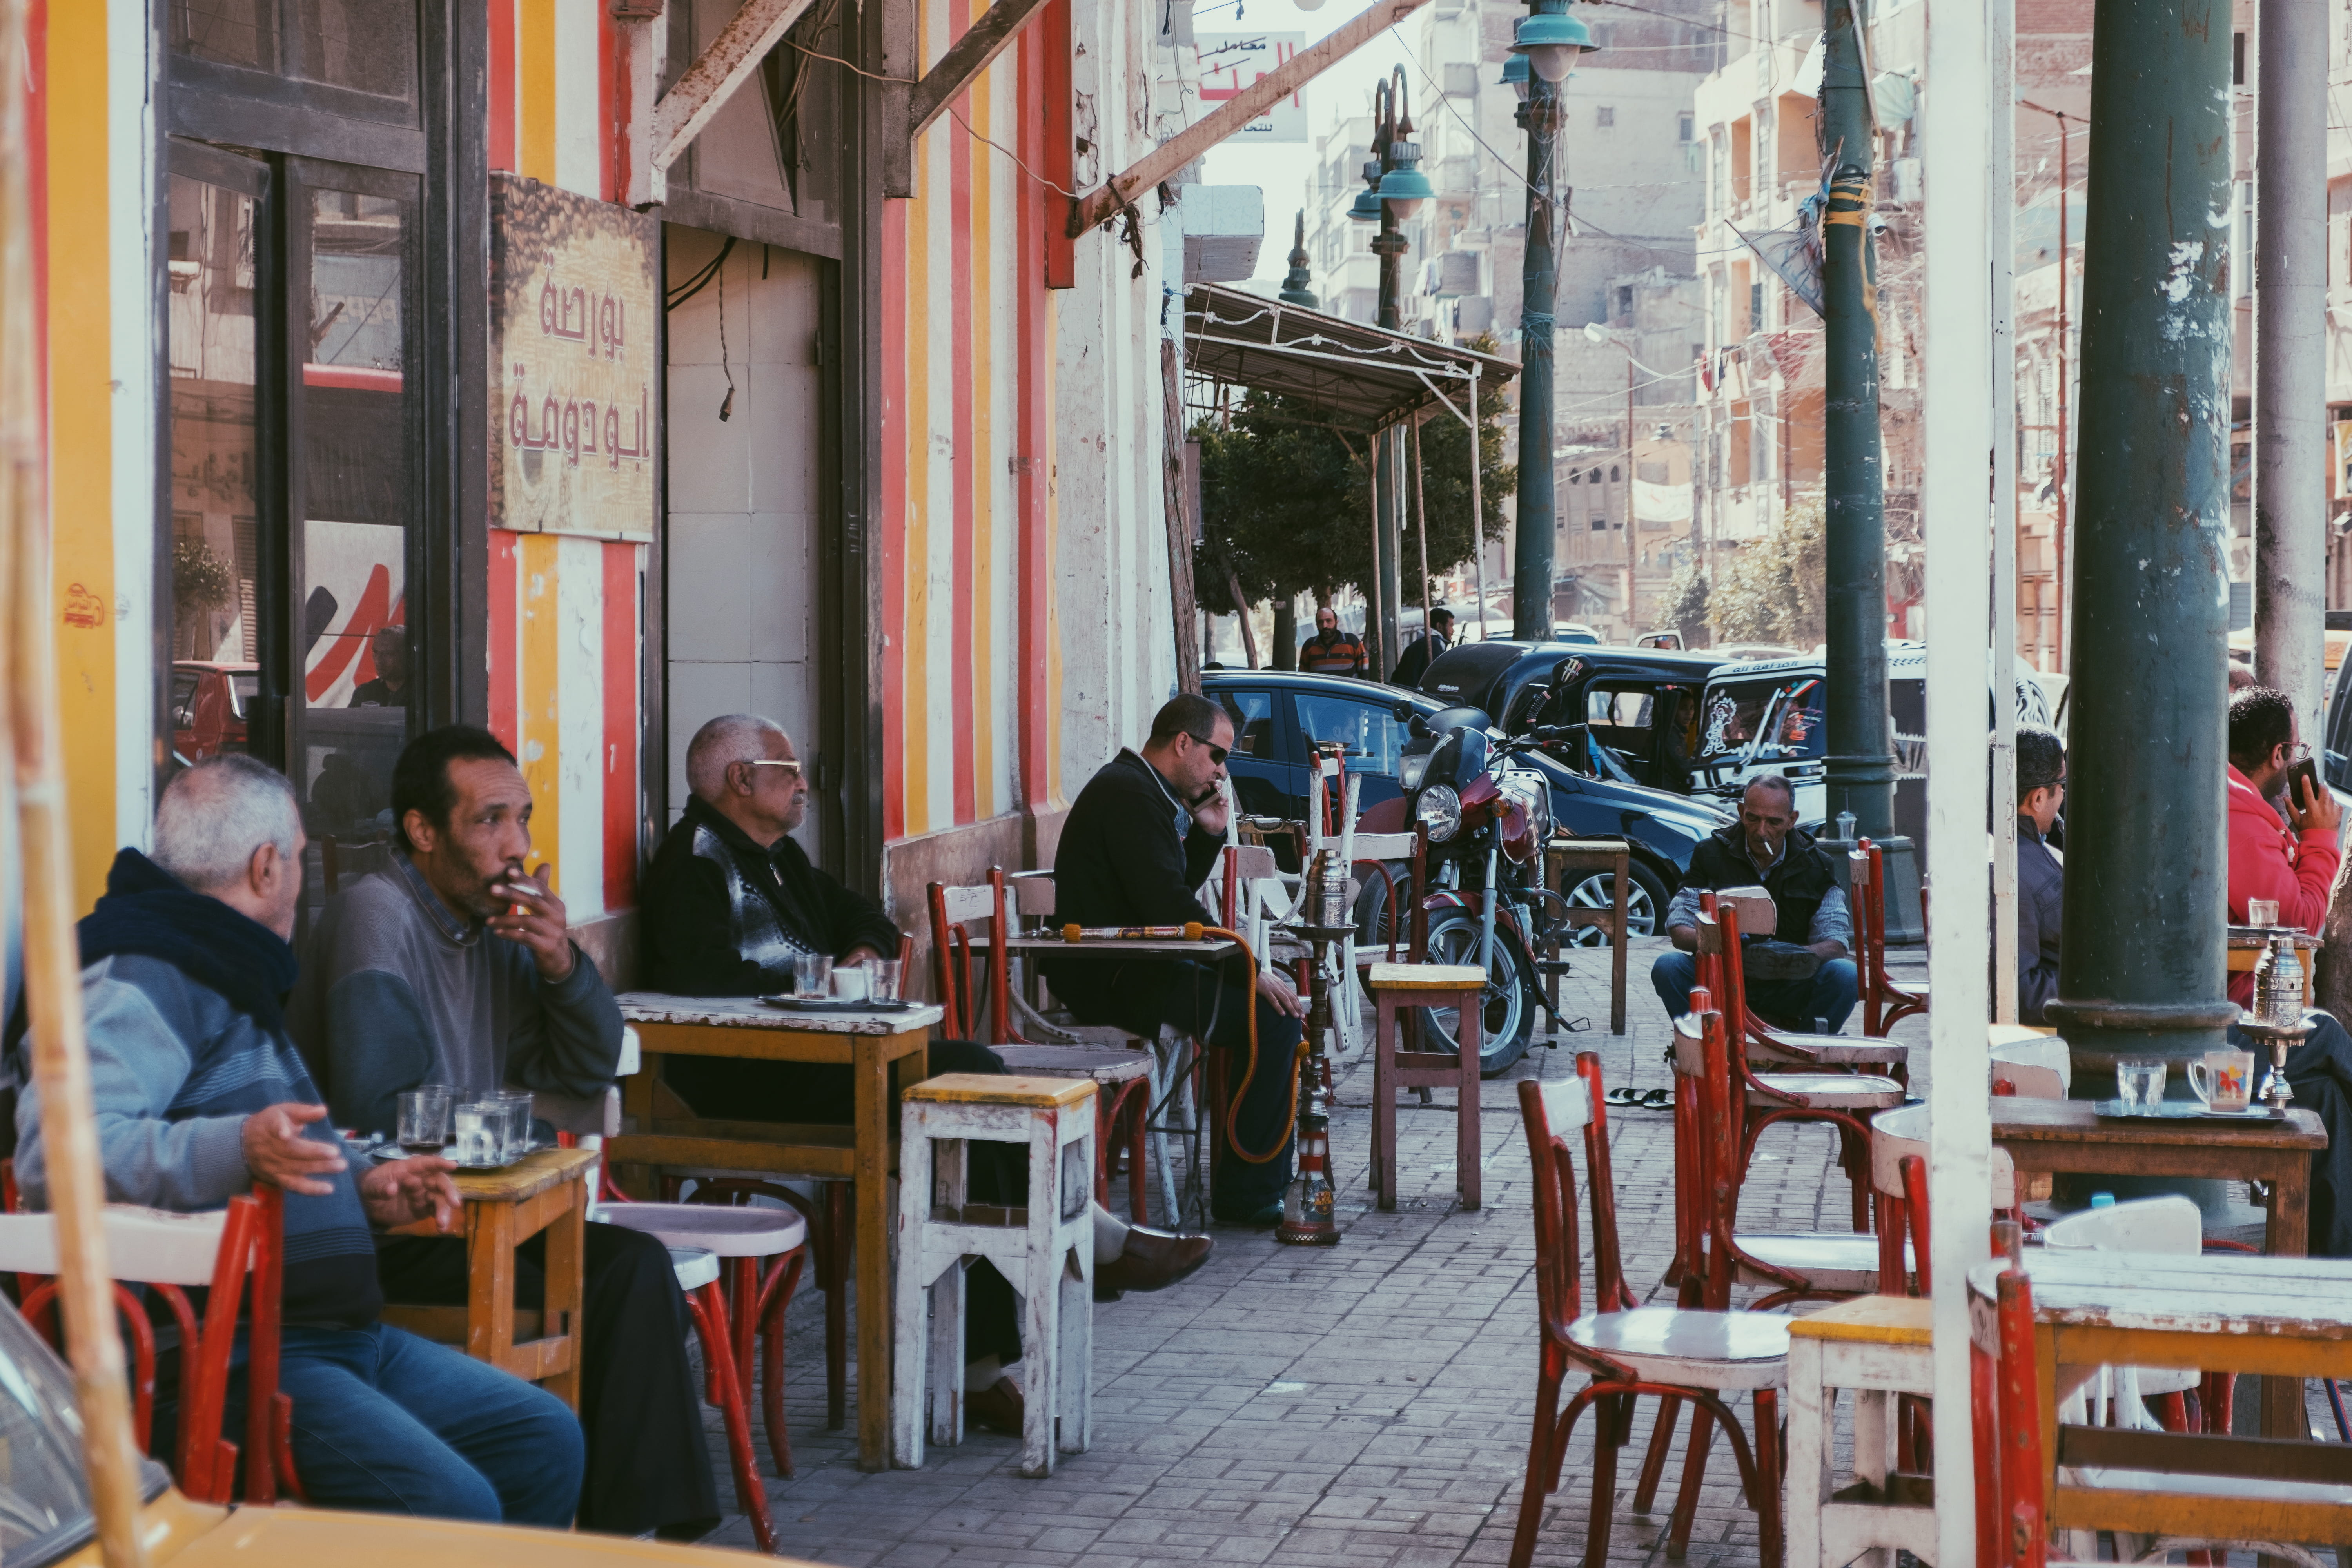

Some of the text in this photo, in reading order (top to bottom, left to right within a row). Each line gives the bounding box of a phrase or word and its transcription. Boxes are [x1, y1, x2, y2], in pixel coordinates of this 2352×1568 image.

[1238, 123, 1272, 132] للتحا
[539, 249, 624, 363] بورصة
[509, 361, 649, 475] أبو دومة
